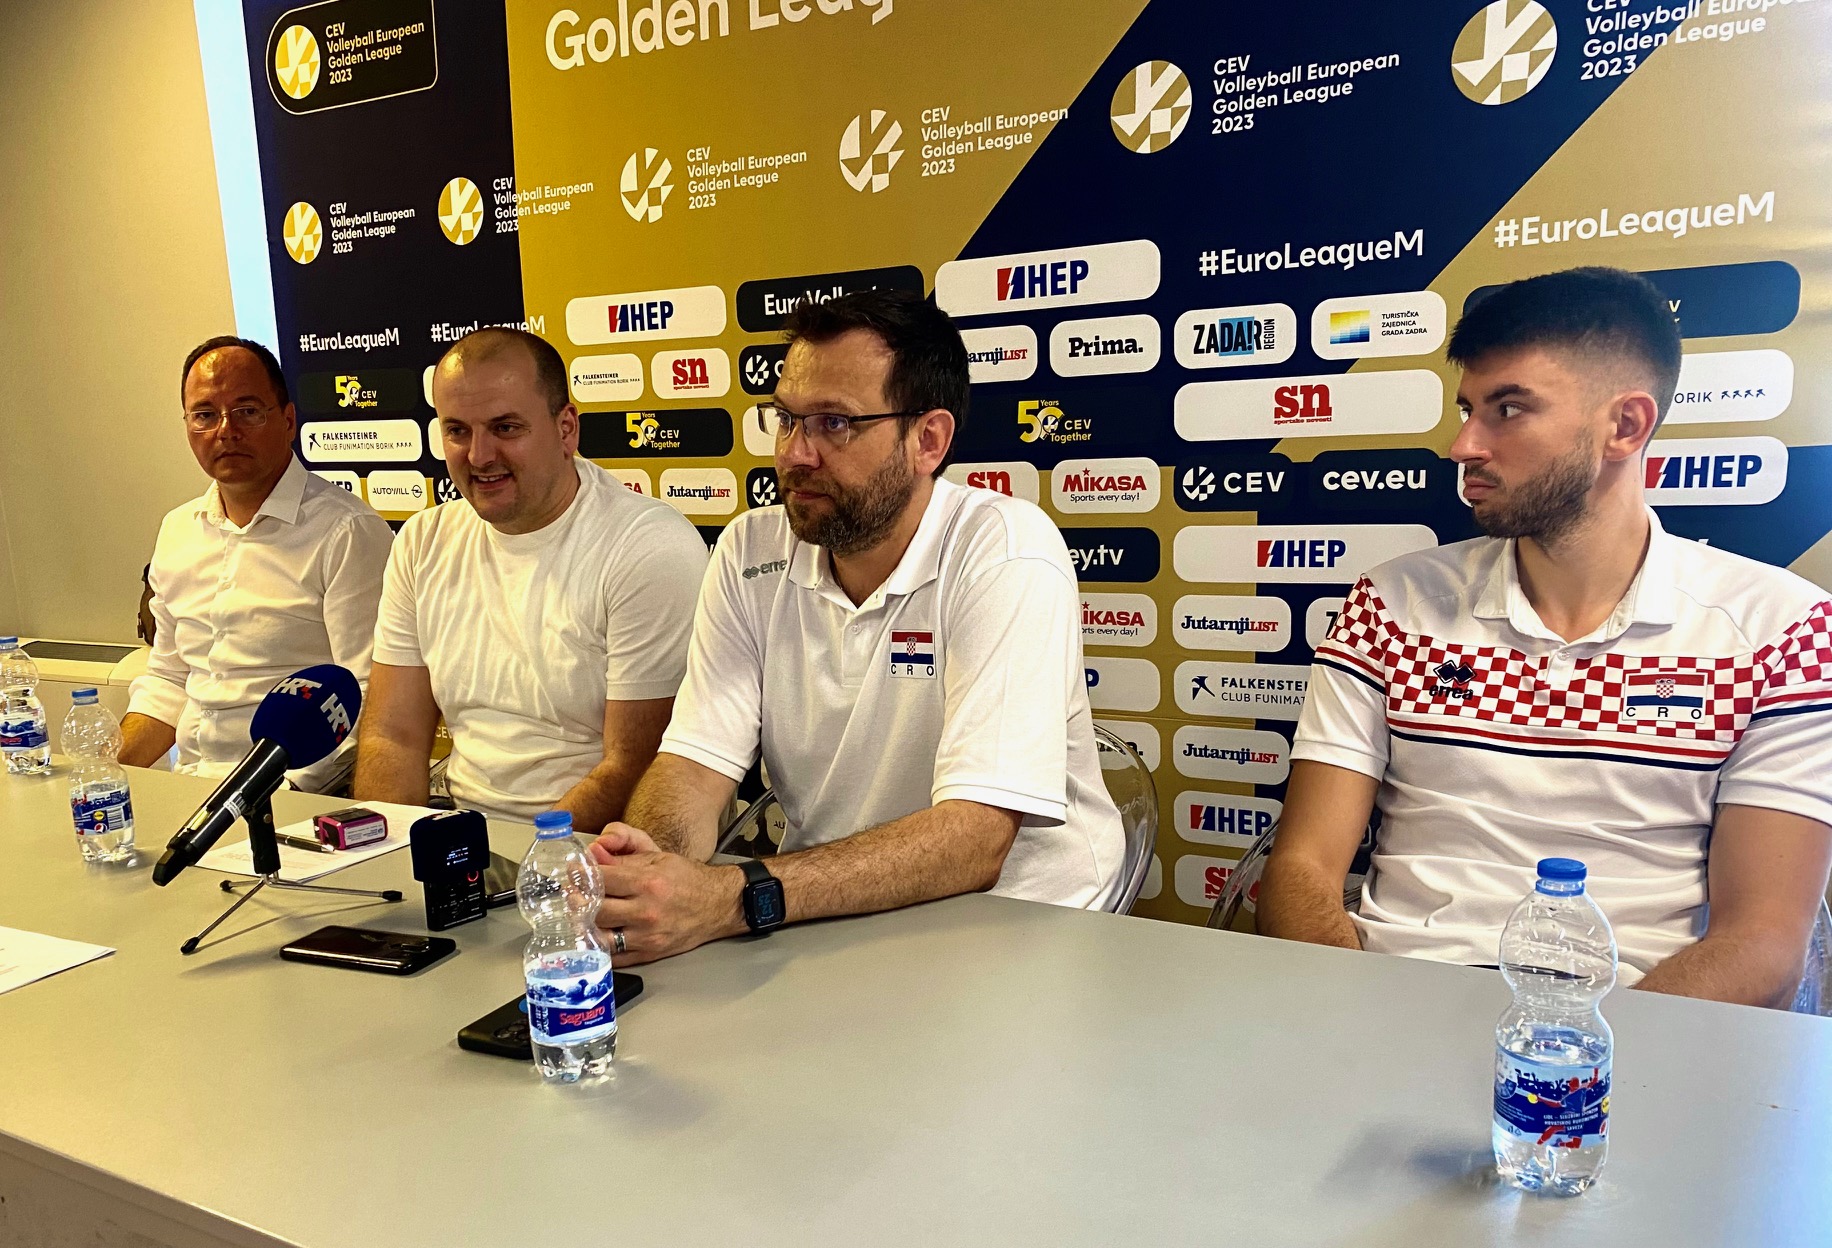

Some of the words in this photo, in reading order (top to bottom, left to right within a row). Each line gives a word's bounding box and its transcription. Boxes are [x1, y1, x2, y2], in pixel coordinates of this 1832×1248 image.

[1585, 1, 1700, 35] Volleyball
[325, 22, 346, 38] CEV
[326, 31, 375, 54] Volleyball
[376, 21, 425, 44] European
[1583, 31, 1668, 58] Golden
[1674, 16, 1767, 44] League
[328, 51, 364, 69] Golden
[365, 43, 403, 63] League
[1214, 55, 1251, 76] CEV
[329, 69, 353, 85] 2023
[1213, 66, 1302, 97] Volleyball
[1306, 52, 1401, 82] European
[1580, 54, 1637, 81] 2023
[1212, 92, 1280, 116] Golden
[1283, 80, 1354, 107] League
[920, 106, 951, 125] CEV
[921, 117, 993, 144] Volleyball
[995, 106, 1069, 132] European
[1212, 113, 1255, 136] 2023
[686, 146, 711, 163] CEV
[921, 138, 975, 160] Golden
[977, 130, 1033, 155] League
[687, 156, 745, 179] Volleyball
[746, 150, 808, 172] European
[921, 158, 956, 178] 2023
[492, 177, 513, 191] CEV
[493, 187, 542, 206] Volleyball
[543, 180, 594, 198] European
[688, 175, 730, 196] Golden
[732, 170, 779, 191] League
[329, 202, 347, 215] CEV
[494, 205, 531, 220] Golden
[533, 199, 571, 217] League
[688, 193, 717, 210] 2023
[330, 213, 372, 230] Volleyball
[373, 207, 416, 223] European
[495, 219, 519, 233] 2023
[1494, 191, 1776, 249] #EuroLeagueM
[331, 227, 362, 242] Golden
[363, 223, 396, 239] League
[332, 241, 353, 254] 2023
[1199, 229, 1425, 277] #EuroLeagueM
[1028, 259, 1090, 298] HEP
[630, 300, 674, 331] HEP
[1381, 311, 1420, 320] TURISTIČKA
[1381, 320, 1417, 328] ZAJEDNICA
[299, 328, 400, 352] #EuroLeagueM
[1263, 318, 1276, 350] REGION
[1381, 328, 1404, 336] GRADA
[1404, 327, 1428, 335] ZADRA
[1068, 335, 1144, 358] Prima.
[672, 358, 709, 386] sn
[361, 390, 377, 399] CEV
[1040, 399, 1060, 407] Years
[1274, 384, 1333, 419] sn
[1674, 391, 1713, 404] ORIK
[660, 430, 680, 439] CEV
[1064, 418, 1092, 430] CEV
[322, 431, 378, 441] FALKENSTEINER
[651, 440, 680, 450] Together
[1050, 432, 1092, 444] Together
[323, 443, 338, 451] CLUB
[1223, 471, 1285, 493] CEV
[1322, 469, 1427, 490] cev.eu
[1683, 454, 1763, 489] HEP
[1070, 494, 1096, 503] Sports
[1097, 494, 1119, 503] every
[1121, 492, 1140, 502] day!
[1286, 539, 1347, 568] HEP
[1081, 610, 1145, 627] IKASA
[1097, 629, 1118, 637] every
[1120, 627, 1138, 637] day!
[1221, 692, 1252, 704] CLUB
[1217, 809, 1272, 836] HEP
[559, 1005, 606, 1027] Saguaro
